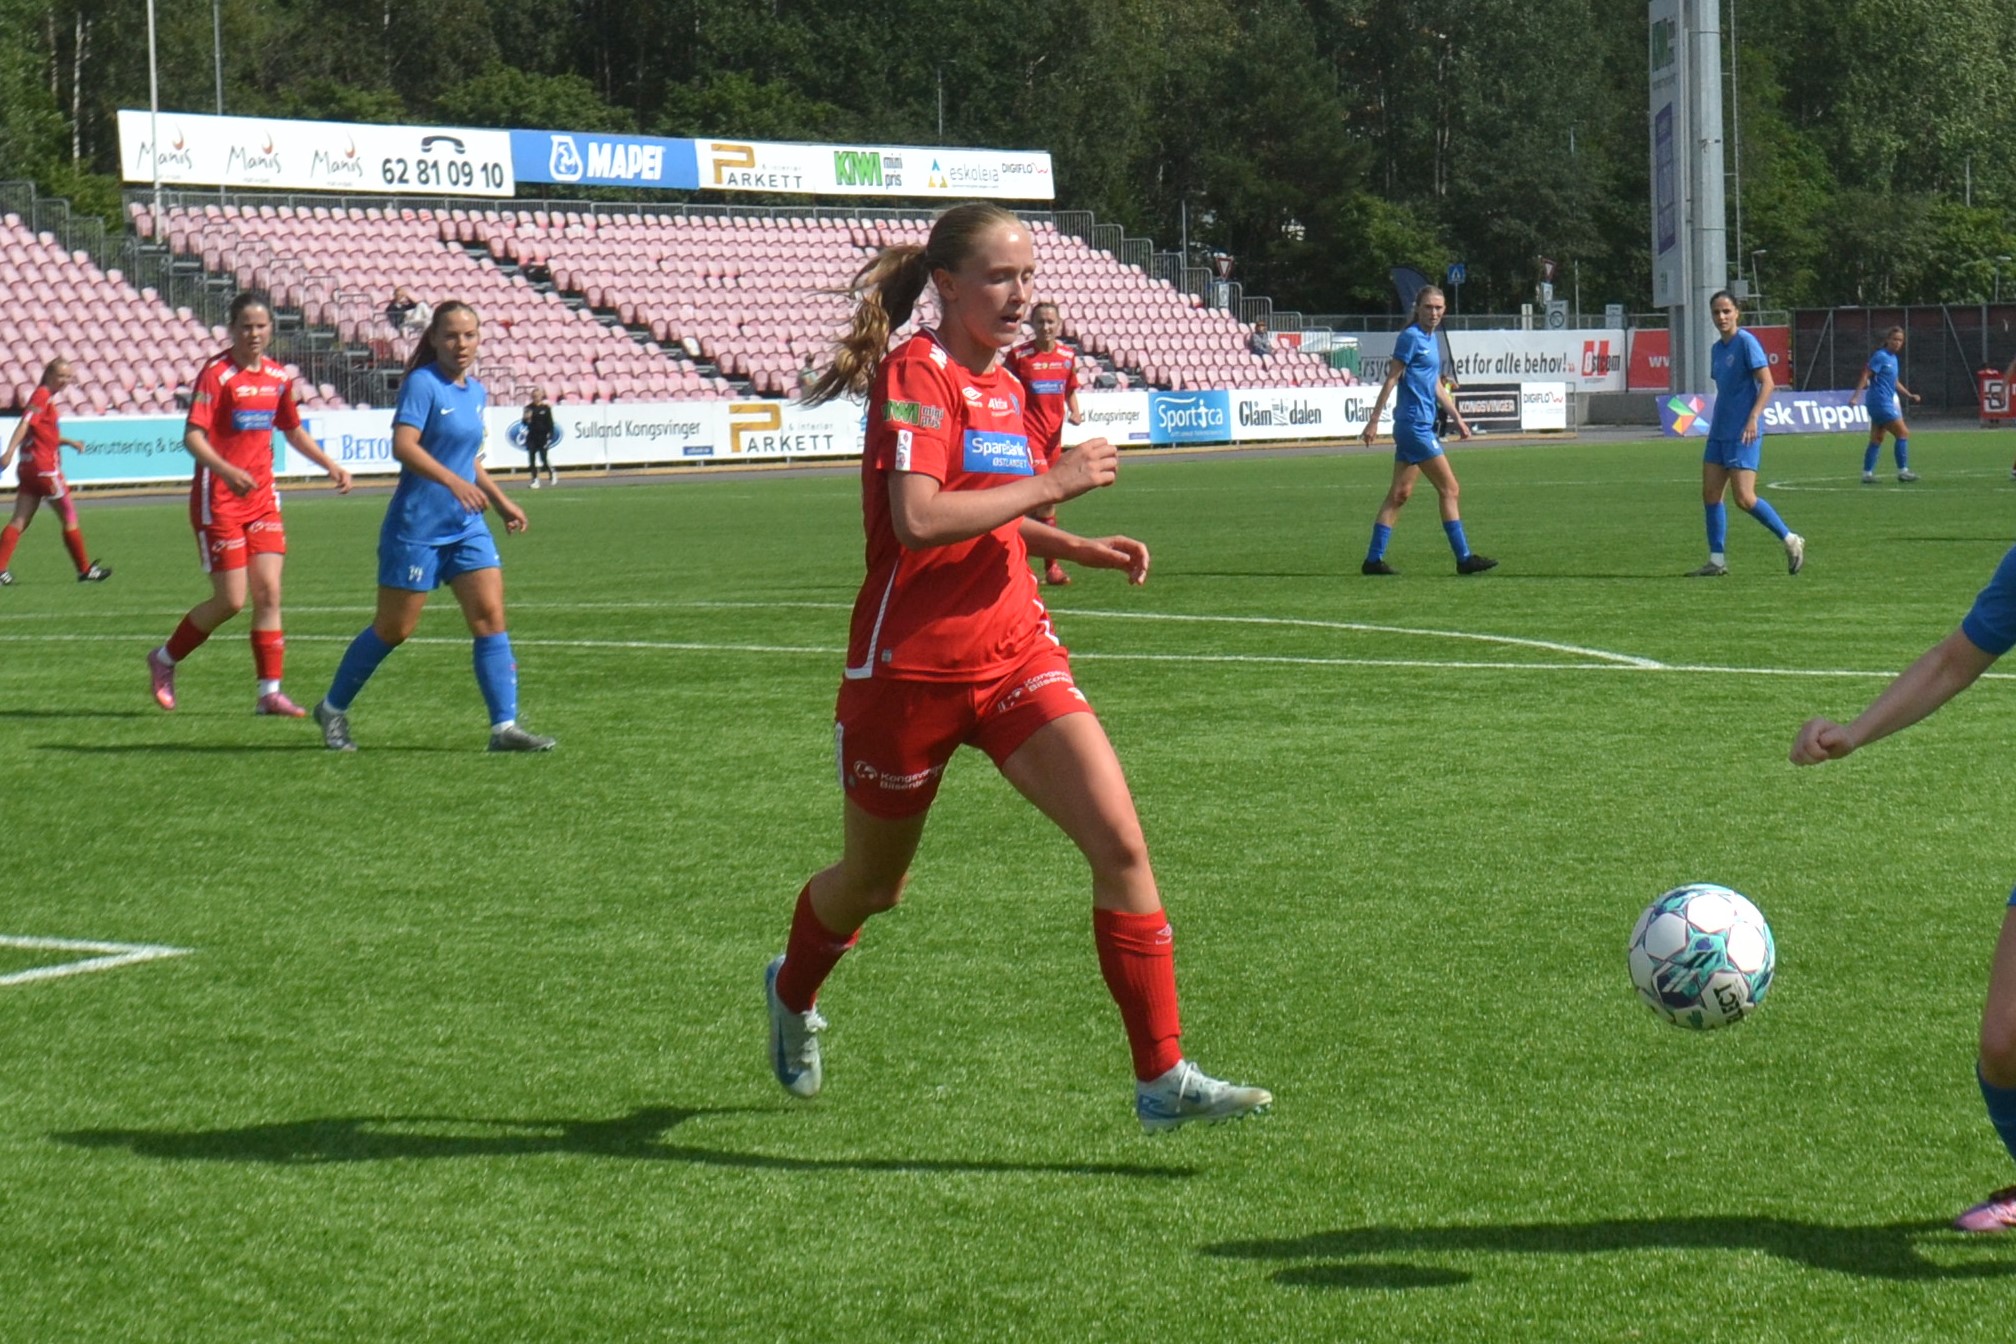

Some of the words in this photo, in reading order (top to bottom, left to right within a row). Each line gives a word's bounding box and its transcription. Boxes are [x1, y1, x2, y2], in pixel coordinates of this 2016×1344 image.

[226, 145, 281, 174] Manis
[310, 149, 364, 178] Manis
[586, 142, 664, 180] MAPEI
[833, 150, 883, 187] KIWI
[382, 157, 410, 185] 62
[416, 158, 441, 186] 81
[448, 160, 474, 187] 09
[480, 162, 504, 189] 10
[884, 170, 902, 189] pris
[1473, 352, 1492, 375] for
[1495, 352, 1521, 375] alle
[1088, 408, 1141, 427] Kongsvinger
[1458, 399, 1516, 414] KONGSVINGER
[574, 420, 622, 439] Sulland
[625, 419, 701, 441] Kongsvinger
[168, 439, 186, 453] be
[341, 434, 391, 461] BETO
